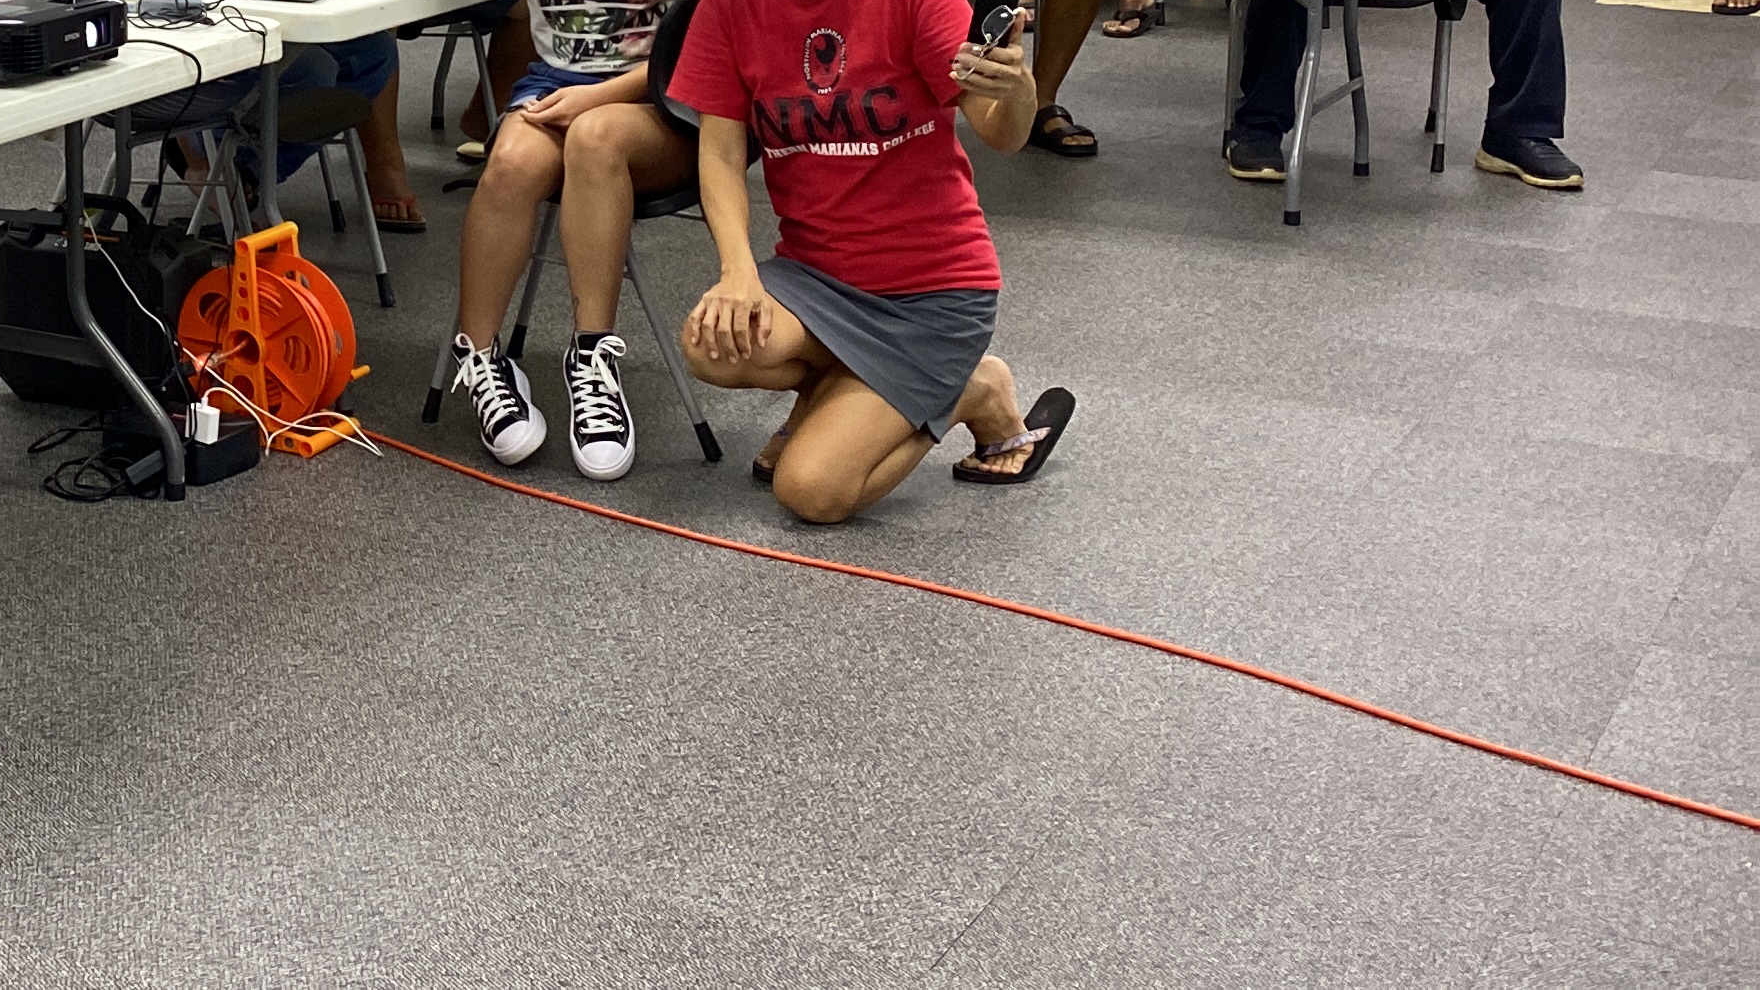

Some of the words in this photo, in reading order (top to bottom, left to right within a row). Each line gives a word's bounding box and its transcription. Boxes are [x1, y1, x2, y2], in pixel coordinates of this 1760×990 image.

[753, 85, 910, 147] NMC
[763, 144, 809, 159] THERN
[808, 142, 879, 156] MARIANAS
[882, 120, 936, 151] COLLEGE
